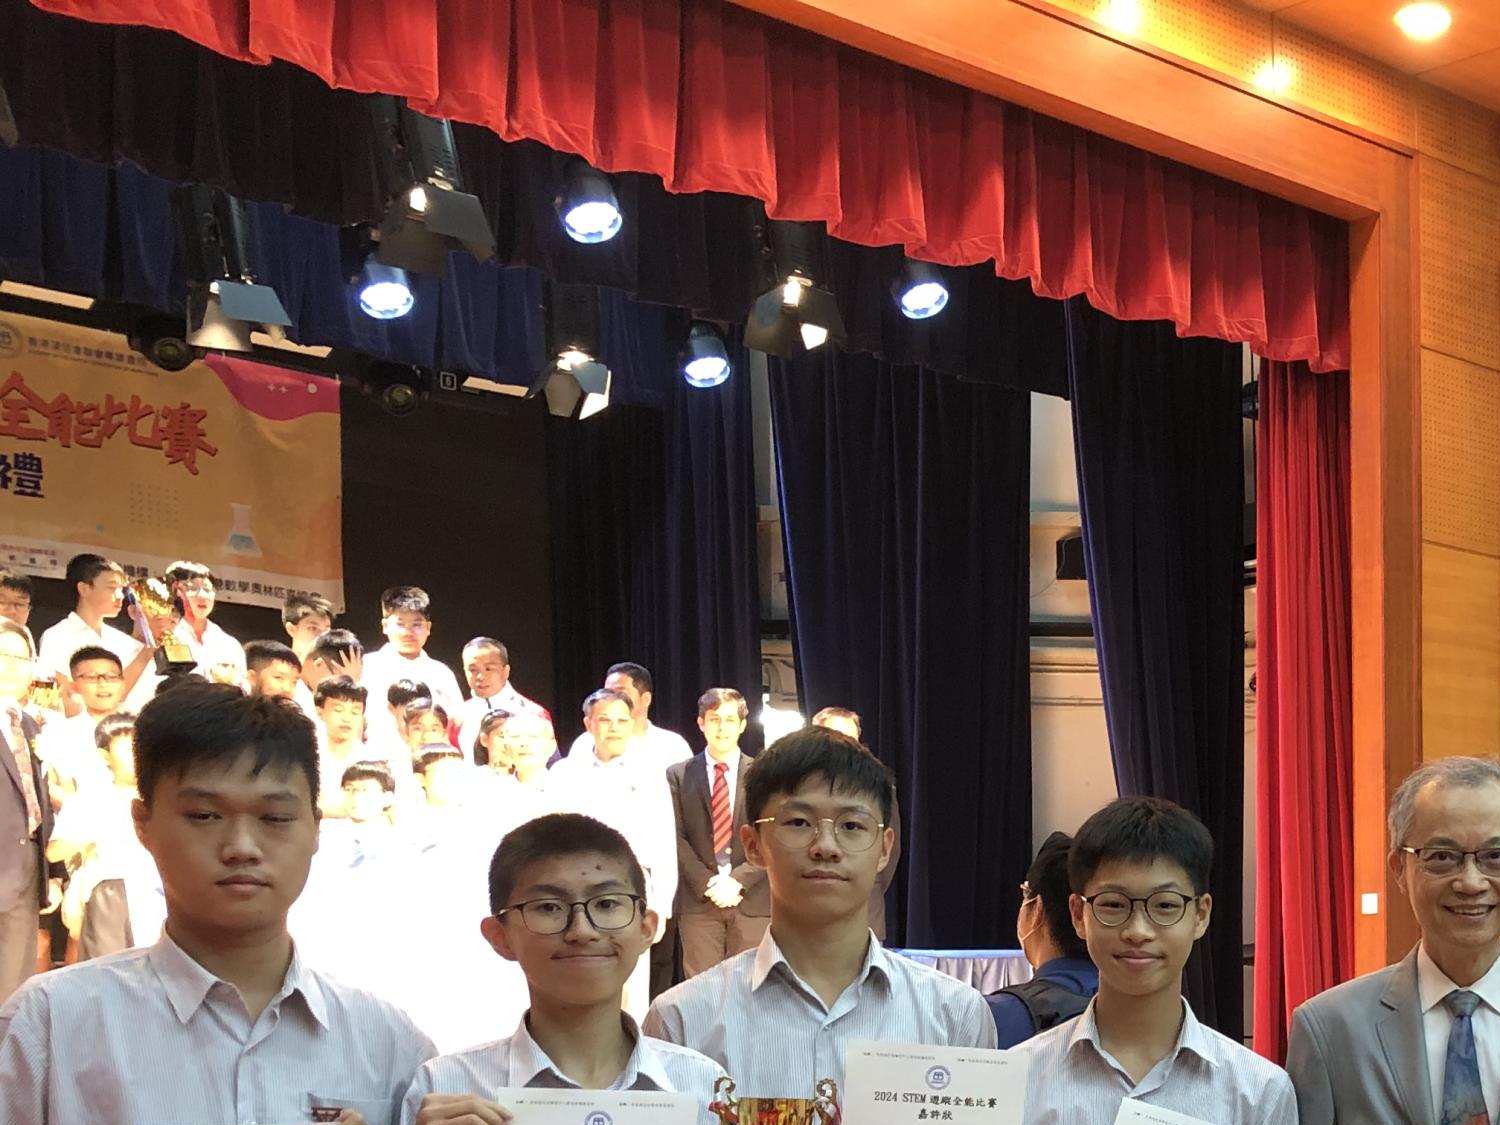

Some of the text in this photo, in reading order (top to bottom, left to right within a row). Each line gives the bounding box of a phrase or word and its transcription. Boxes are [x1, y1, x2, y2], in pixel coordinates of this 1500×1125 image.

[0, 371, 218, 476] 全能比賽
[874, 1091, 898, 1102] 2024
[902, 1093, 926, 1104] STEM
